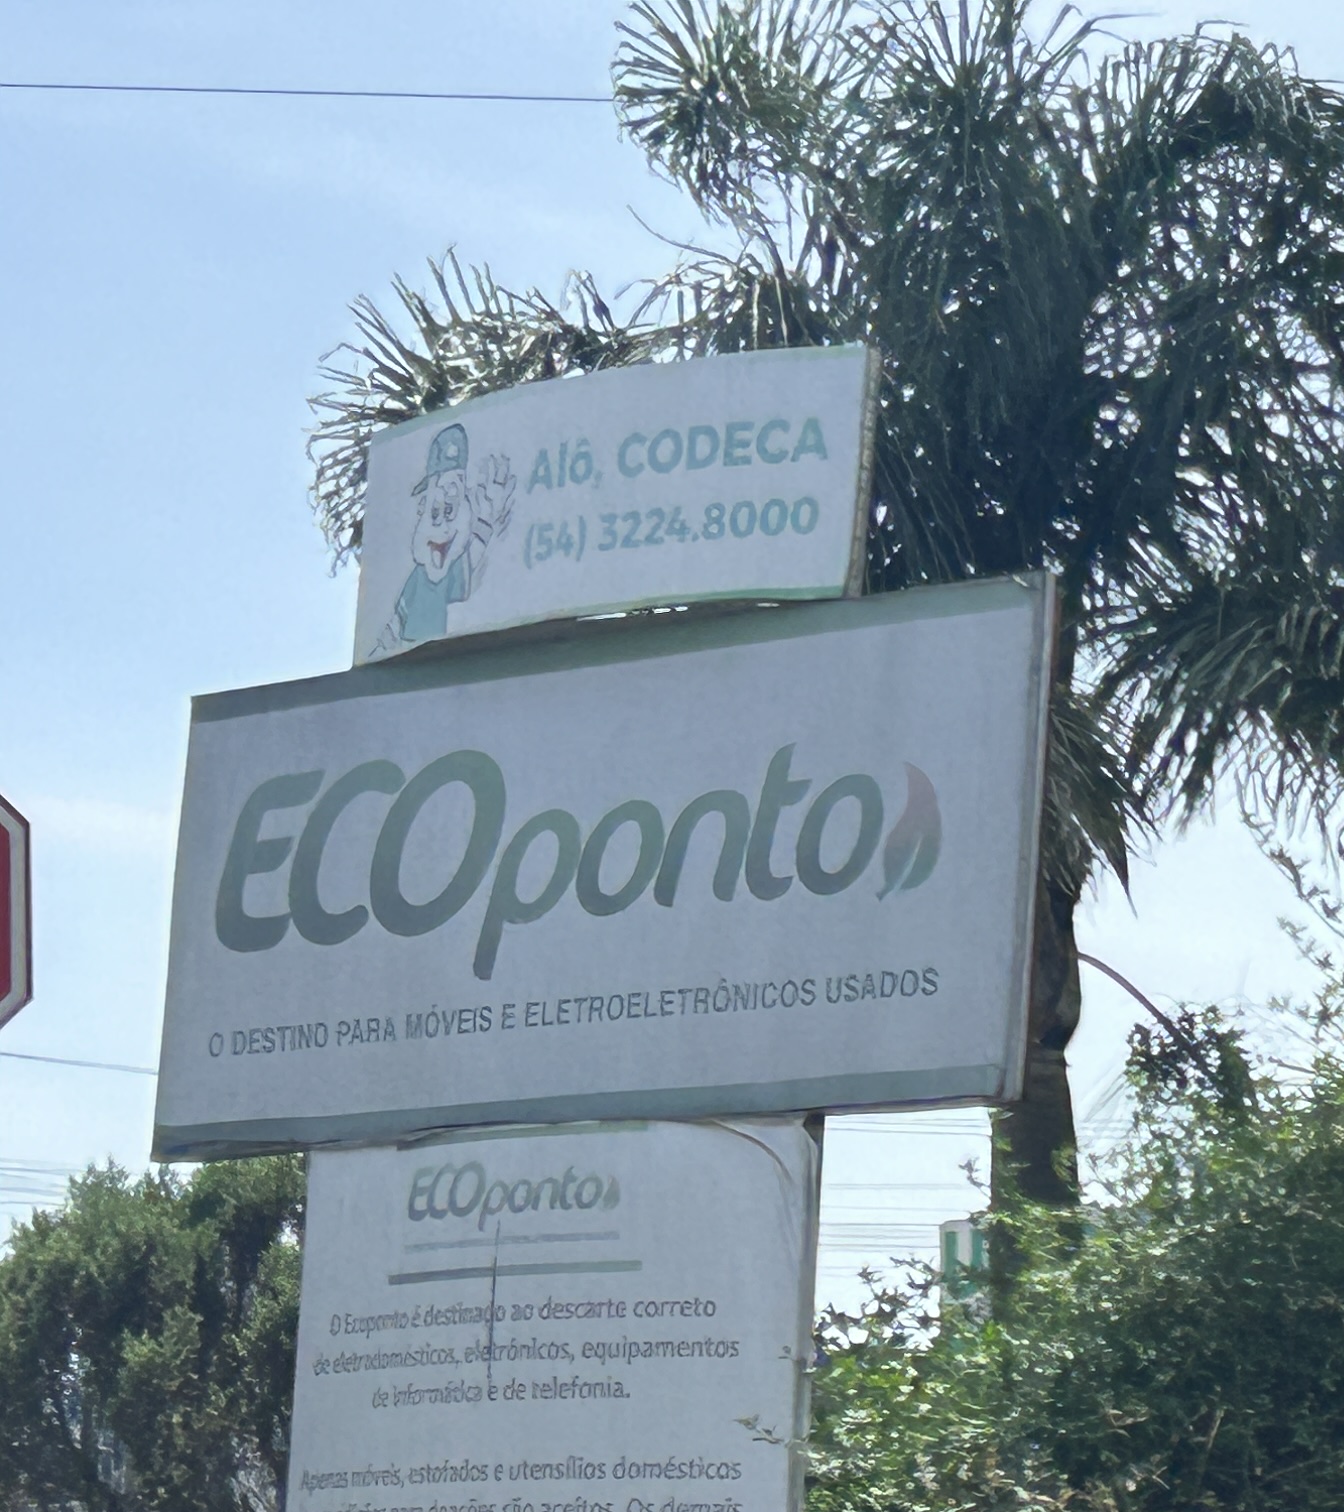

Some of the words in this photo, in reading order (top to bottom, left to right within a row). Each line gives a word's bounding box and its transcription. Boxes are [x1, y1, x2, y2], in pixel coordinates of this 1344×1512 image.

[526, 439, 602, 494] Alô,
[617, 417, 828, 479] CODECA
[523, 516, 587, 569] (54)
[598, 496, 819, 553] 3224.8000
[215, 743, 883, 980] ECOponto
[209, 1032, 223, 1057] O
[232, 1023, 328, 1055] DESTINO
[336, 1018, 396, 1046] PARA
[405, 1004, 492, 1038] MÓVEIS
[501, 1003, 515, 1030] E
[525, 978, 816, 1027] ELETROELETRÔNICOS
[826, 967, 939, 1003] USADOS
[408, 1160, 602, 1231] ECOponto
[330, 1314, 341, 1335] O
[344, 1310, 407, 1338] Ecoponto
[412, 1305, 422, 1328] é
[424, 1302, 506, 1327] destinado
[511, 1304, 533, 1321] ao
[539, 1296, 626, 1320] descarte
[633, 1298, 717, 1318] correto
[582, 1336, 740, 1365] equipamentos
[487, 1384, 498, 1401] e
[503, 1378, 526, 1400] de
[532, 1376, 631, 1400] telefonia.
[407, 1459, 489, 1484] estofados
[494, 1464, 504, 1481] e
[509, 1456, 606, 1480] utensílios
[612, 1456, 742, 1480] domésticos
